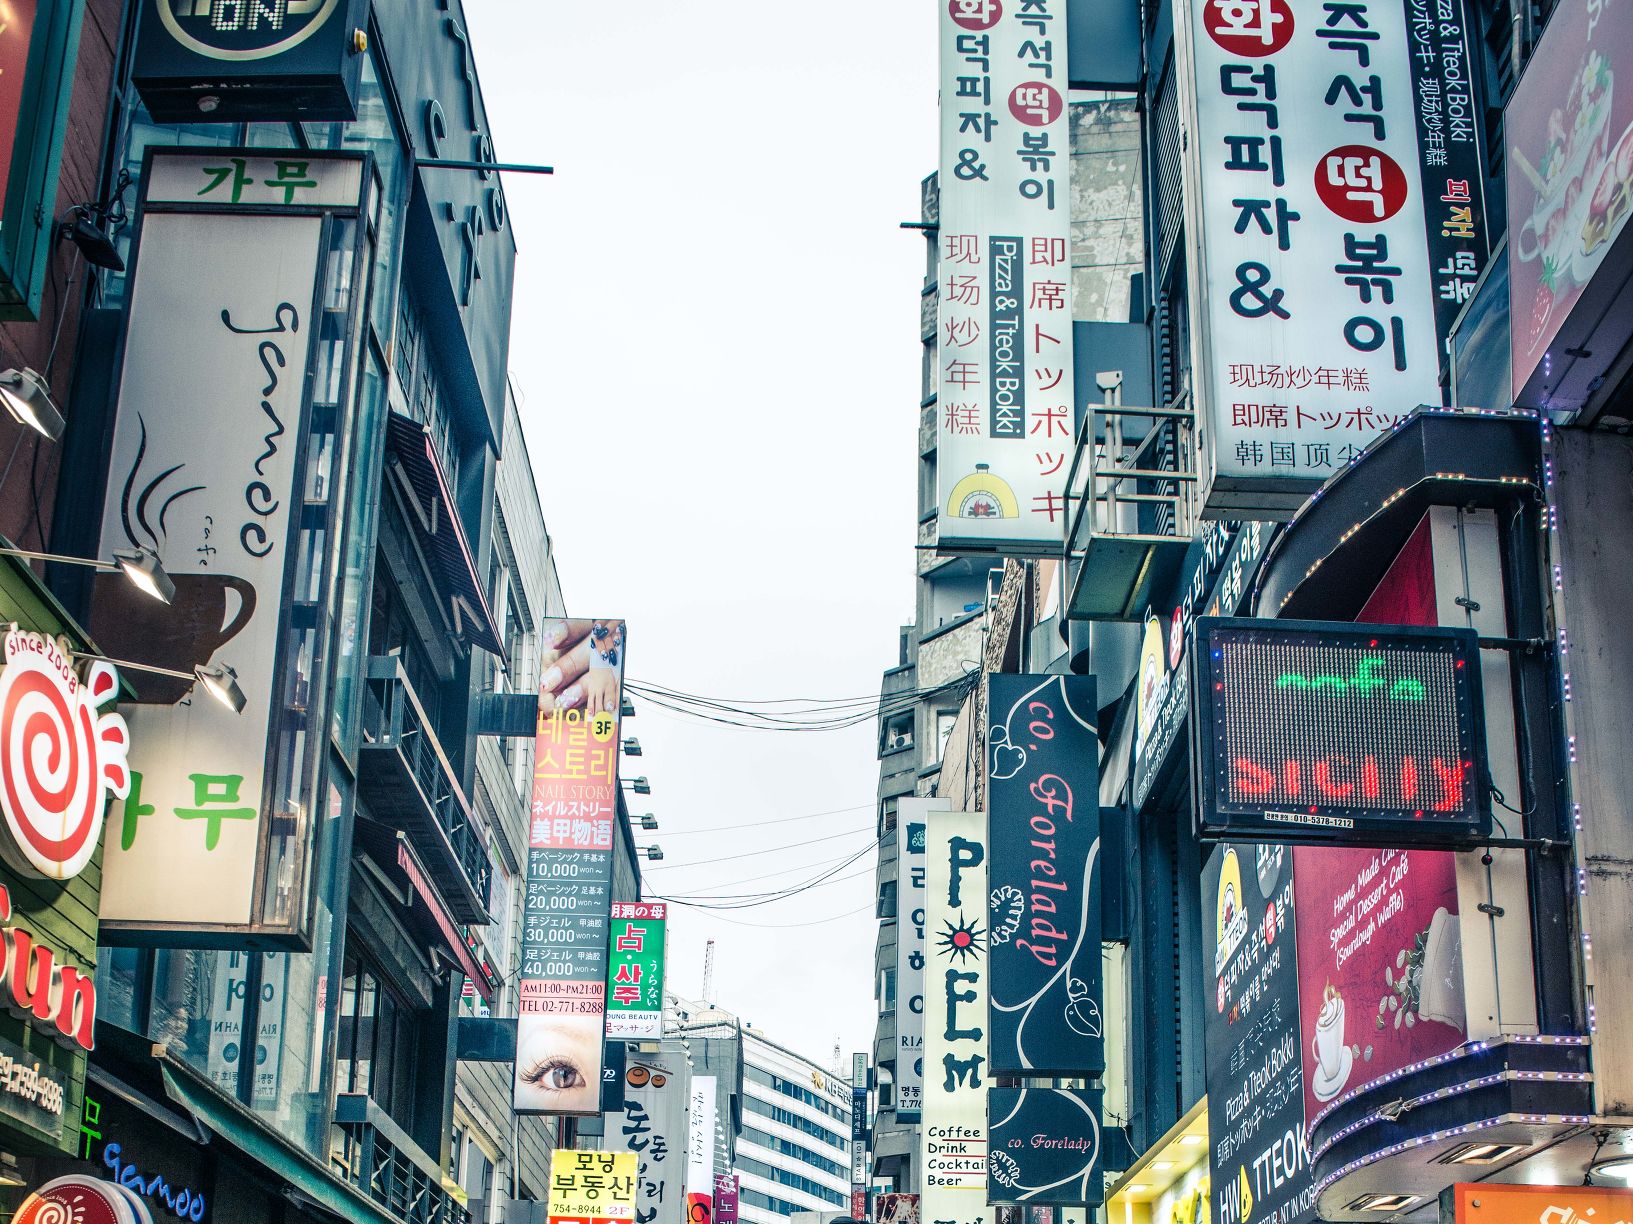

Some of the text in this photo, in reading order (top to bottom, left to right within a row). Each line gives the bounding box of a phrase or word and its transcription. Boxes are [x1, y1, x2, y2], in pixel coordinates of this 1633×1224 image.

[1441, 40, 1468, 91] Tteok
[1446, 92, 1474, 143] Bokki
[197, 158, 318, 204] 가무
[1315, 2, 1407, 372] 즉석떡볶이
[1440, 178, 1476, 239] 피자!
[945, 234, 981, 435] 现场炒年糕
[994, 240, 1021, 433] Pizza & Tteok Bokki
[1029, 236, 1069, 523] 即席トッポッキ
[1228, 363, 1370, 392] 现场炒年糕
[1231, 402, 1403, 432] 即席トッポッ
[9, 632, 76, 695] since 2008
[538, 709, 589, 746] 네일
[595, 720, 612, 735] 3F
[534, 749, 614, 785] 스토리
[535, 784, 614, 800] NAIL STORY
[120, 770, 258, 852] 무
[532, 801, 612, 817] ネイルストリー
[1293, 814, 1353, 828] 010-5378-1212
[530, 818, 612, 846] 美甲物语
[530, 851, 580, 862] 手ベーシック
[1016, 773, 1074, 967] Forelady
[530, 863, 579, 878] 10,000
[528, 884, 579, 895] 足ベーシック
[1333, 855, 1380, 918] Home Made
[528, 896, 577, 911] 20,000
[1330, 904, 1356, 952] Special
[1357, 876, 1388, 922] Dessert
[527, 916, 572, 927] 手ジェル
[1336, 916, 1376, 971] (Sourdough
[1376, 888, 1404, 929] Waffle)
[525, 929, 575, 943] 30,000
[525, 949, 573, 960] 足ジェル
[524, 962, 574, 977] 40,000
[646, 959, 659, 1007] うらない
[519, 1000, 604, 1014] TEL 02-771-8288
[1225, 1092, 1244, 1126] Pizza
[1249, 1054, 1272, 1100] Tteok
[1270, 1027, 1295, 1078] Bokki
[927, 1125, 980, 1138] Coffee
[1030, 1133, 1091, 1154] Forelady
[927, 1142, 967, 1154] Drink
[575, 1153, 616, 1174] 모닝
[927, 1159, 986, 1170] Cocktai
[552, 1175, 635, 1202] 부동산
[927, 1174, 962, 1186] Beer
[553, 1203, 630, 1216] 754-8944 2F
